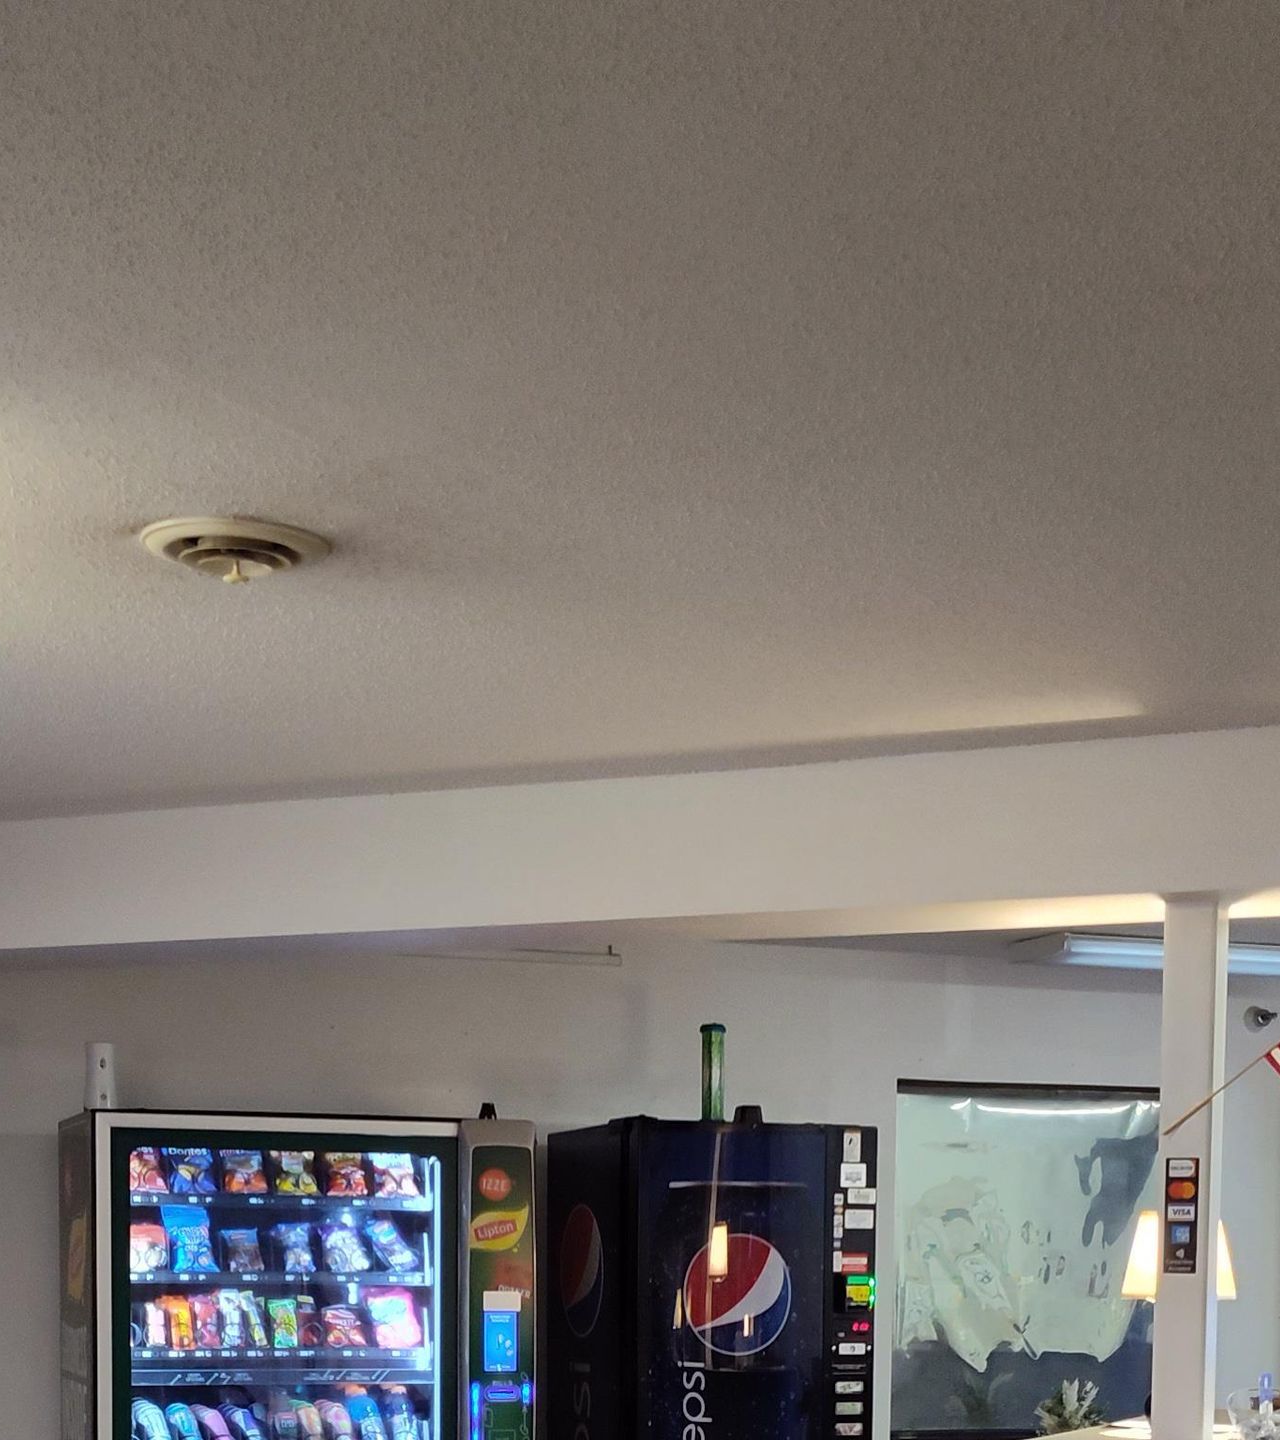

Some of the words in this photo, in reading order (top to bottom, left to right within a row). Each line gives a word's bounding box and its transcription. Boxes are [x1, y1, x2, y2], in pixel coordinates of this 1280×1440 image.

[482, 1178, 507, 1191] IZZE
[1171, 1208, 1191, 1216] VISA
[477, 1222, 514, 1239] Lipton
